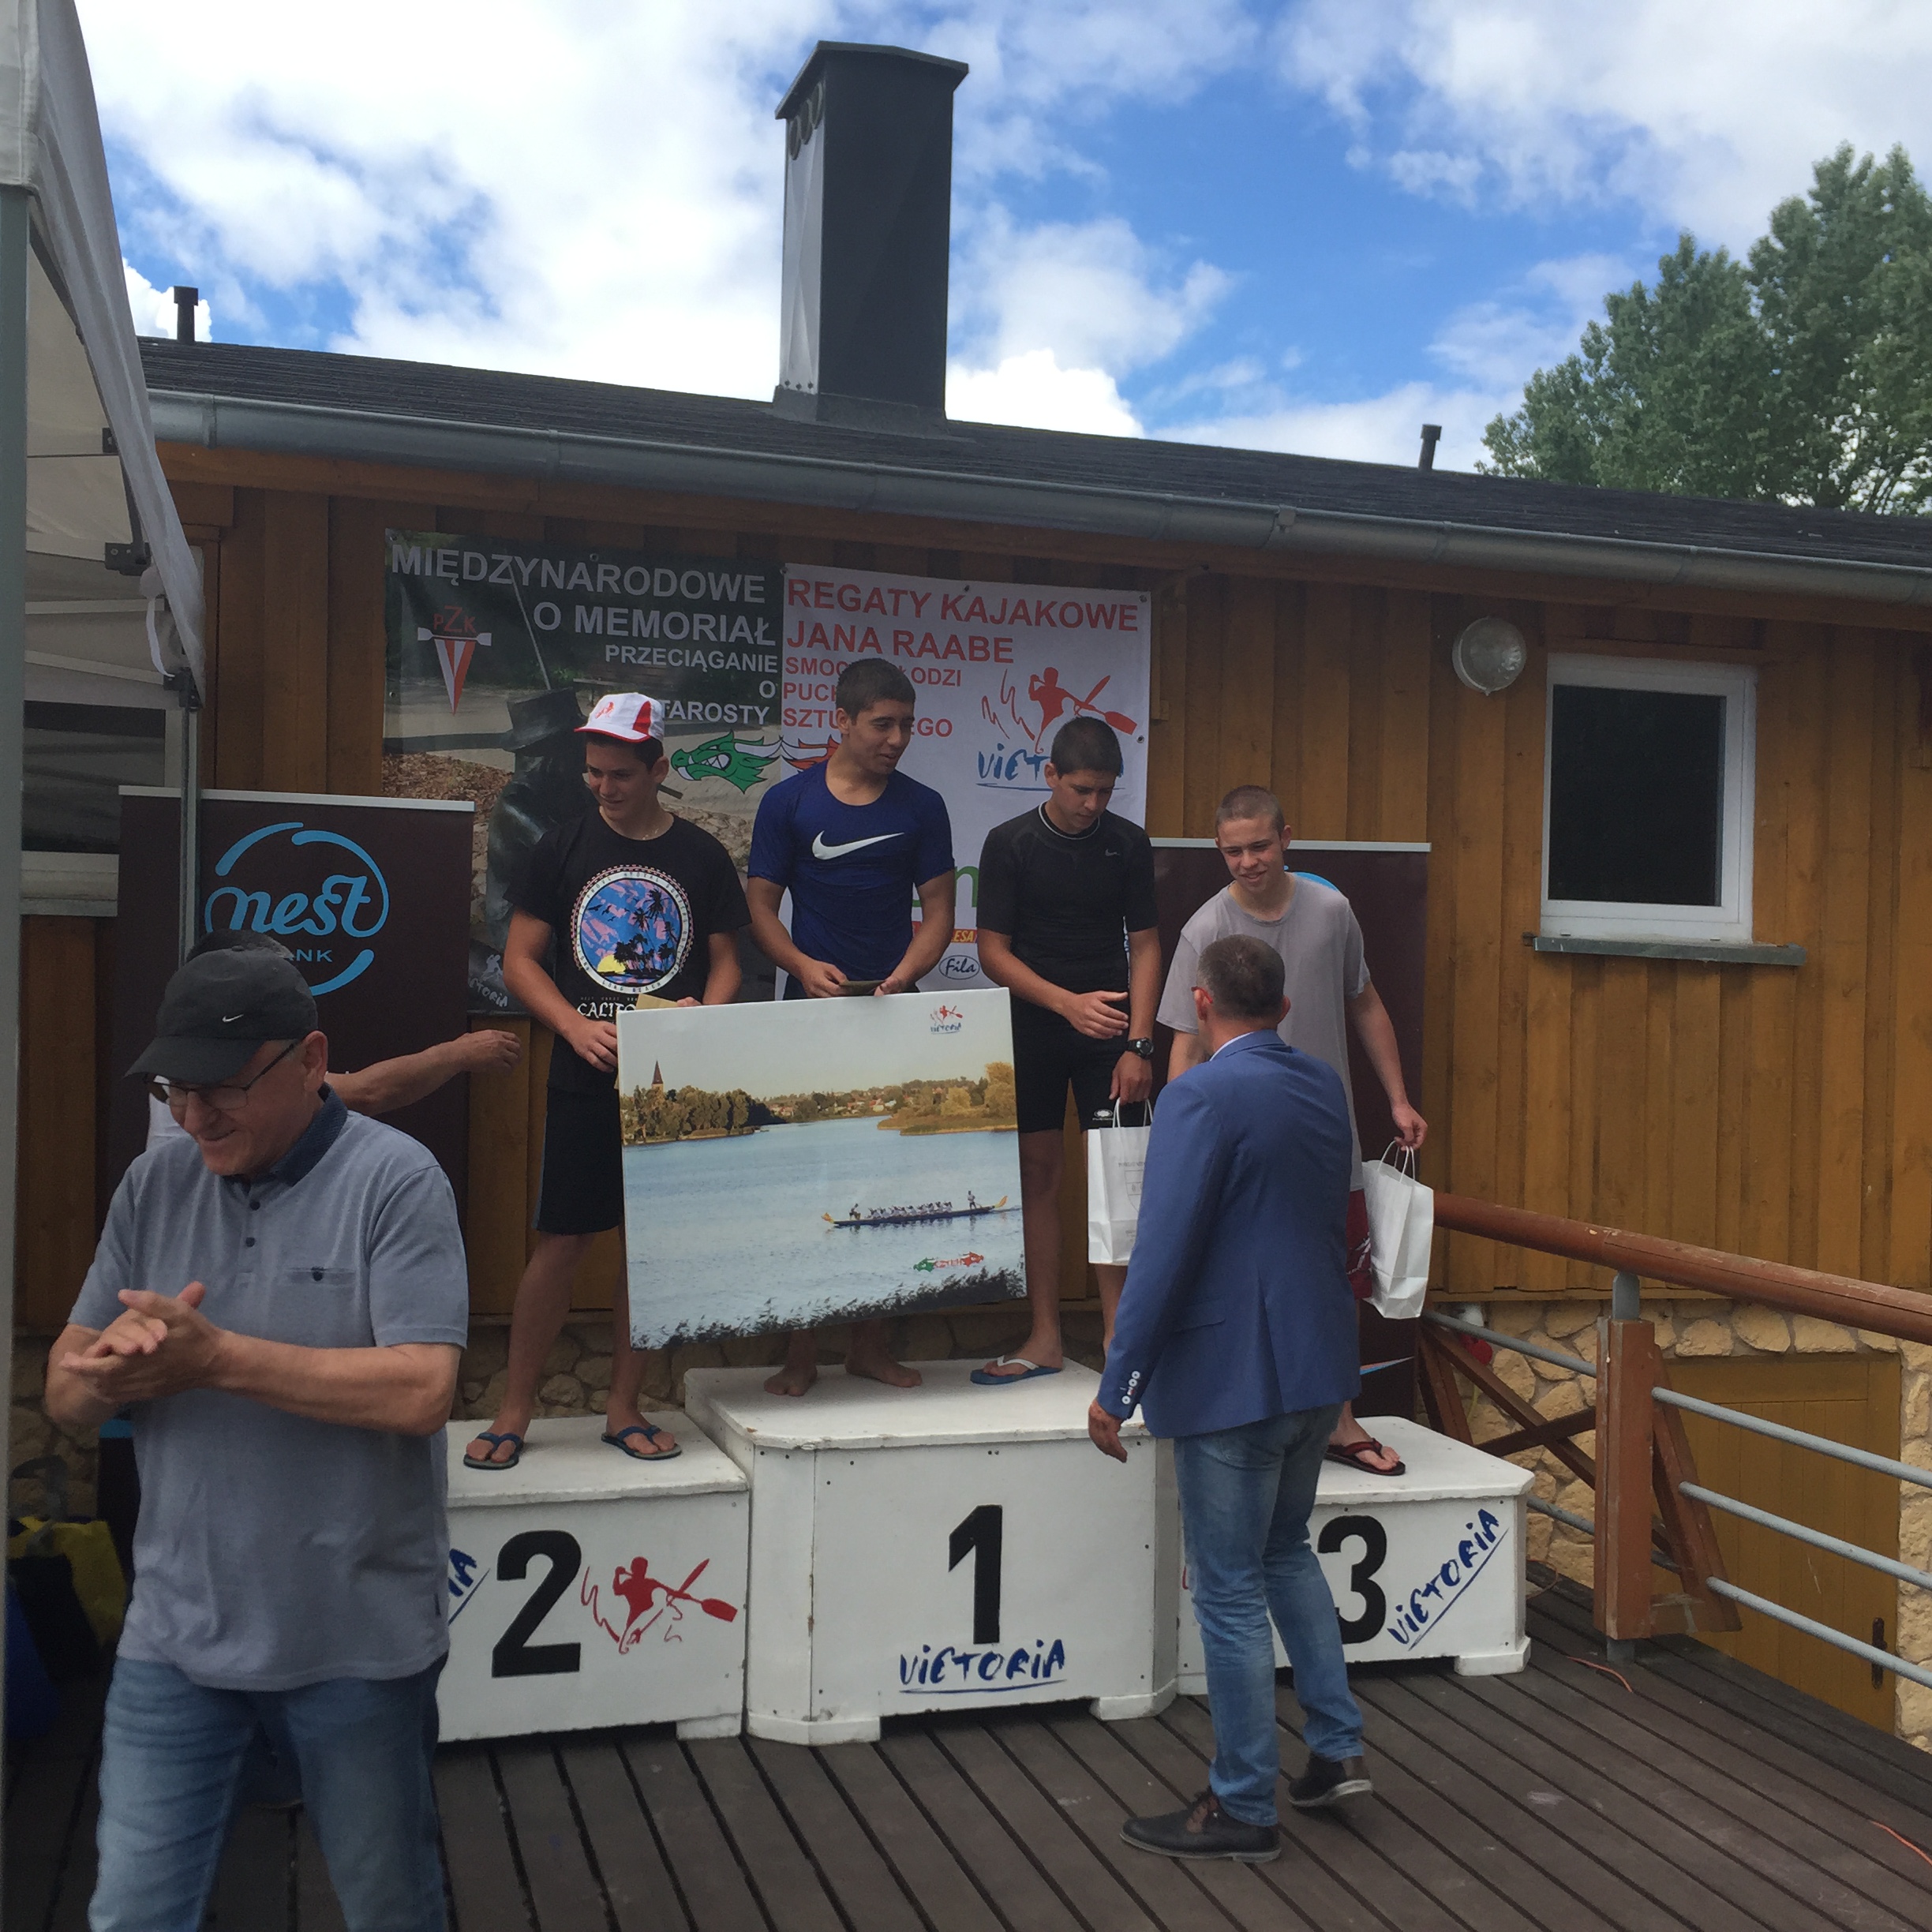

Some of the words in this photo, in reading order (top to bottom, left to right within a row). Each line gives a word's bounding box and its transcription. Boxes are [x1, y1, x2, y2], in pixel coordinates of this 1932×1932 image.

[392, 545, 766, 603] MIĘDZYNARODOWE
[432, 605, 477, 634] PZK
[534, 601, 561, 631] O
[575, 605, 777, 646] MEMORIAŁ
[788, 578, 931, 618] REGATY
[940, 593, 1138, 631] KAJAKOWE
[605, 645, 778, 673] PRZECIĄGANIE
[786, 620, 882, 655] JANA
[893, 629, 1014, 664] RAABE
[758, 680, 776, 698] O
[899, 665, 961, 687] ODZI
[660, 699, 770, 725] TAROSTY
[950, 930, 975, 943] ESA
[948, 1504, 1003, 1645] 1
[1317, 1515, 1387, 1645] 3
[492, 1530, 582, 1678] 2
